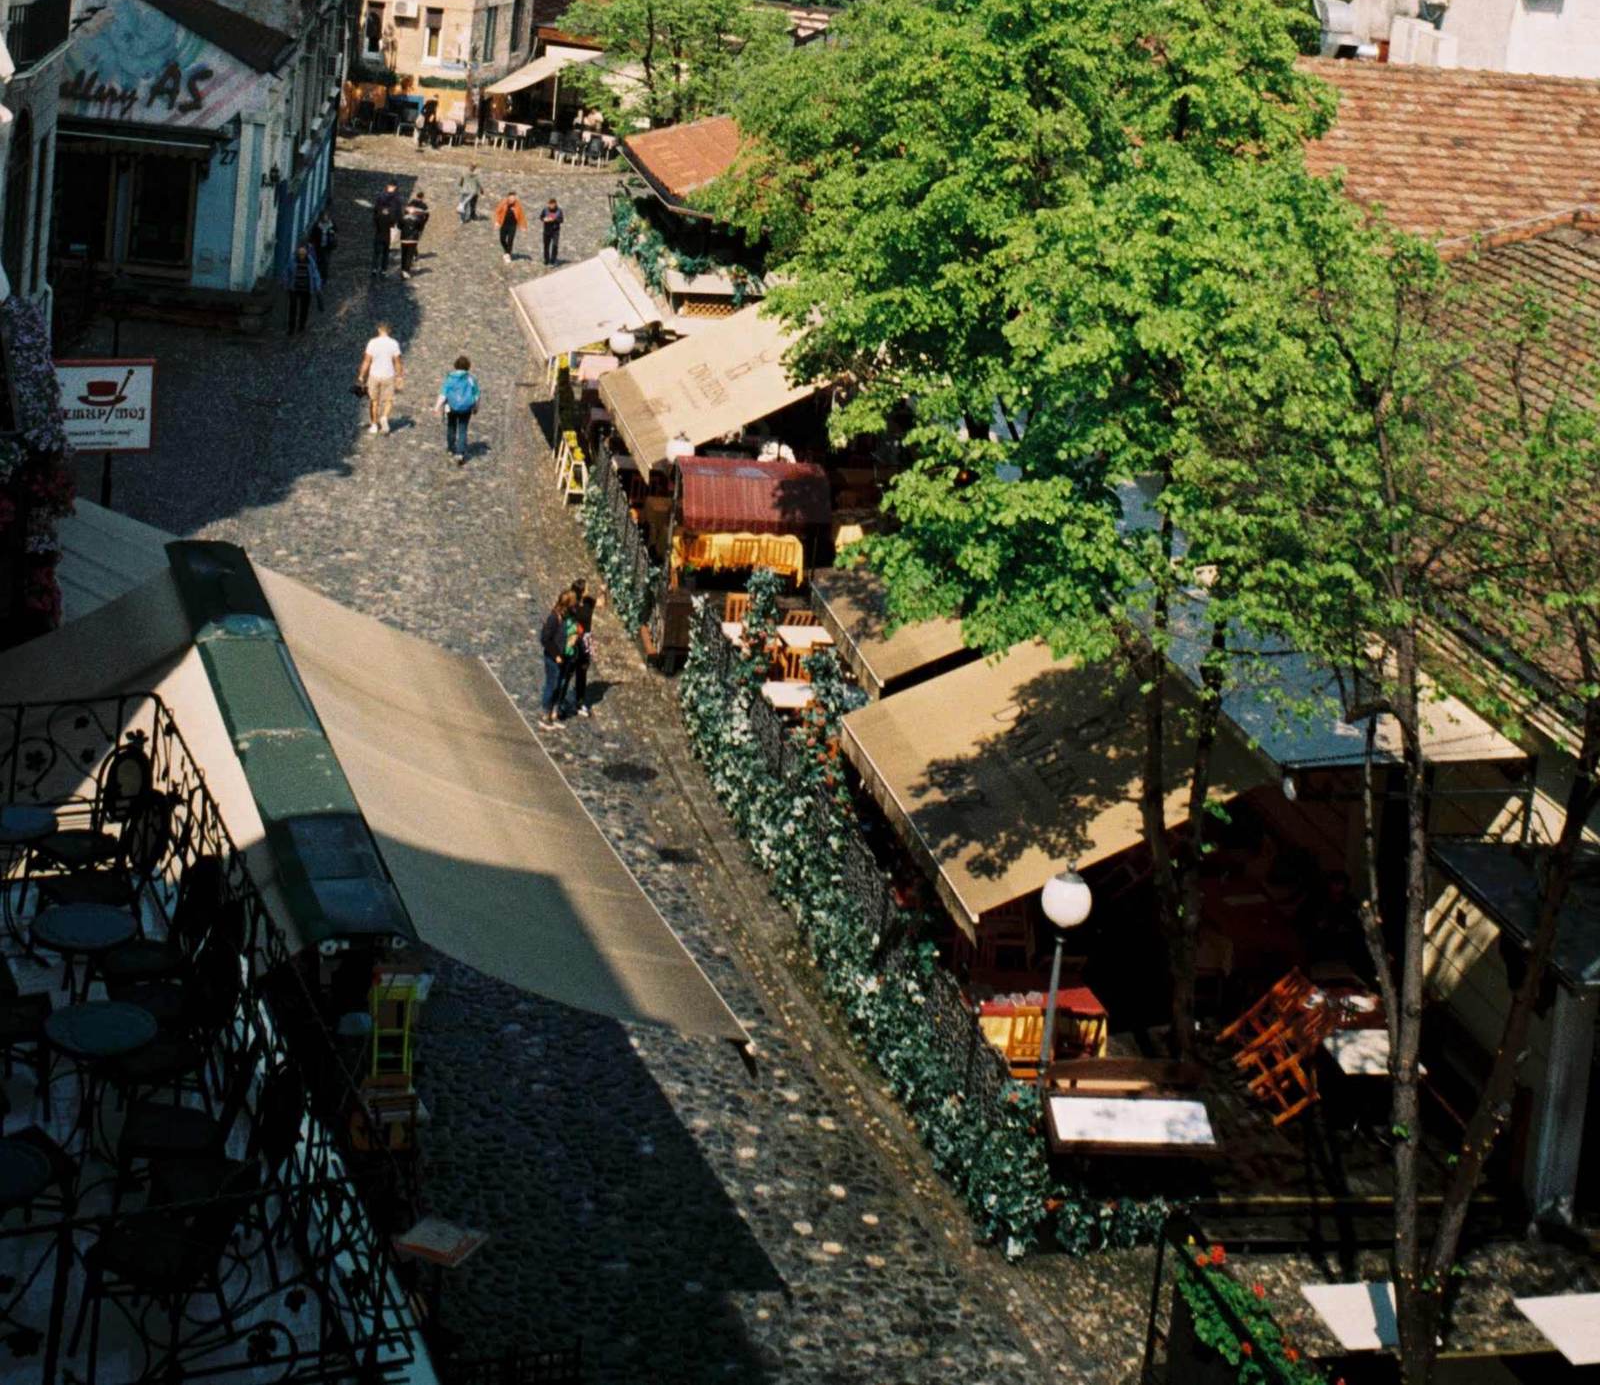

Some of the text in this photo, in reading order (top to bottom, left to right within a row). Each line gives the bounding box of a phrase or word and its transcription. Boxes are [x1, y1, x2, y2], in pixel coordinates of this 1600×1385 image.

[58, 60, 214, 115] allery AS
[219, 150, 238, 166] 27
[62, 407, 107, 420] ЕШИР
